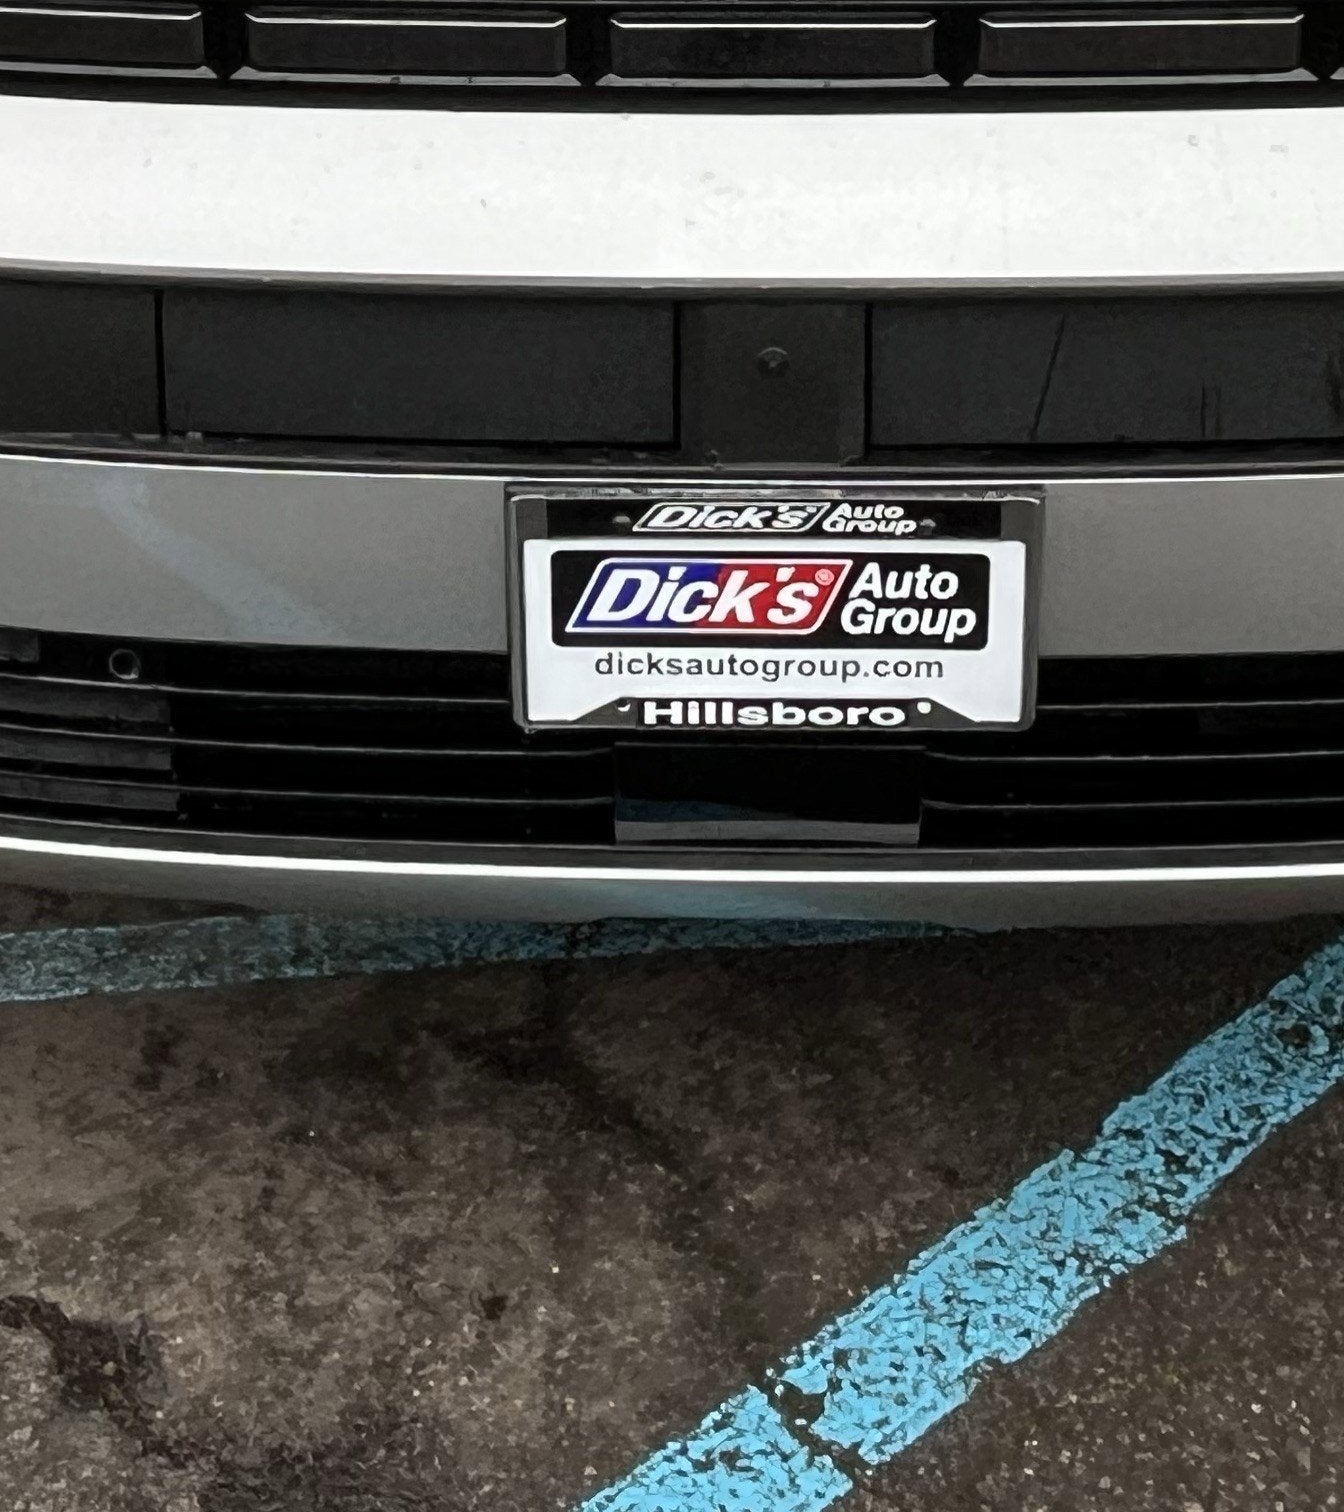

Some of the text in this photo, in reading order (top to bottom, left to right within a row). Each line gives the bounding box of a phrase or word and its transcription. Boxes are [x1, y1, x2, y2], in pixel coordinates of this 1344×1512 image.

[828, 503, 904, 519] Auto
[822, 518, 917, 535] Group
[848, 562, 959, 600] Auto
[841, 598, 977, 643] Group
[594, 651, 944, 683] dicksautogroup.com
[643, 701, 906, 726] Hillsboro
